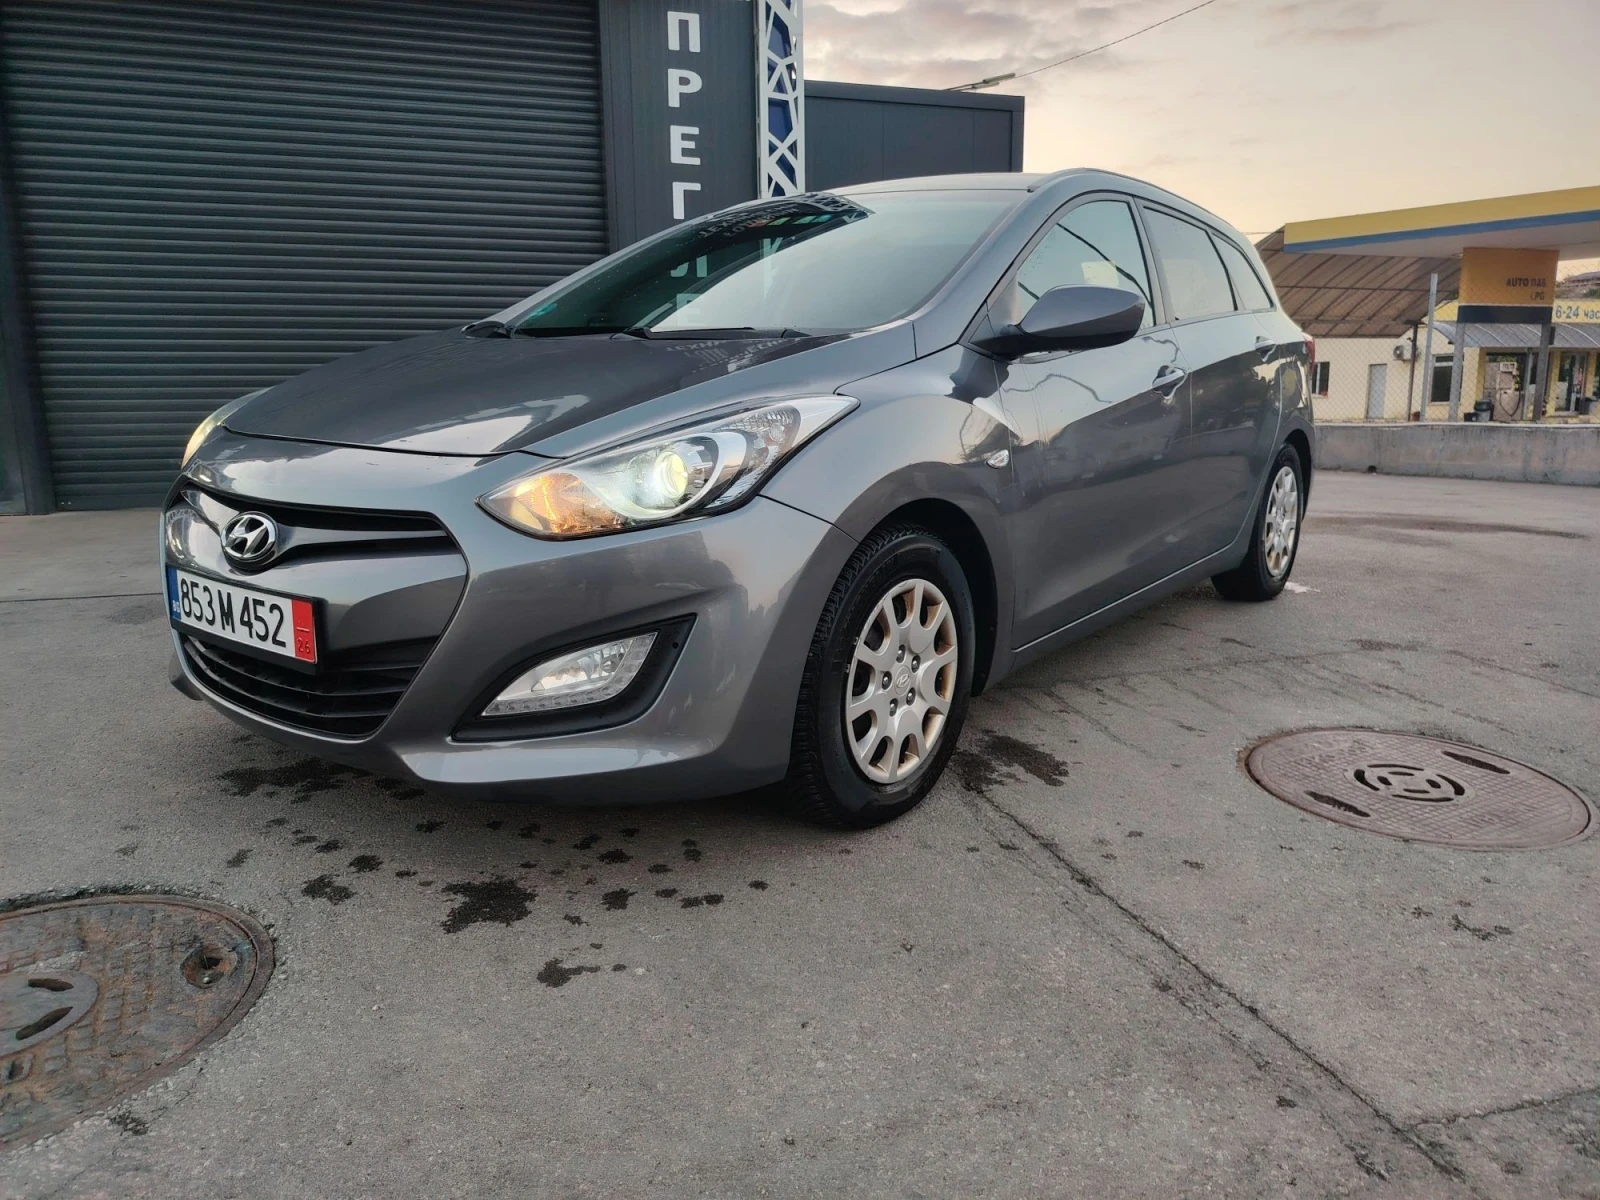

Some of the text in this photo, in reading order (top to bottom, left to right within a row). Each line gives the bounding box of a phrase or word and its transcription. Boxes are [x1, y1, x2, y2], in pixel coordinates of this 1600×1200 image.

[1506, 277, 1529, 288] AUTO
[1555, 304, 1580, 319] 6-24
[180, 577, 216, 626] 853
[239, 596, 286, 648] 452
[296, 637, 311, 654] 26
